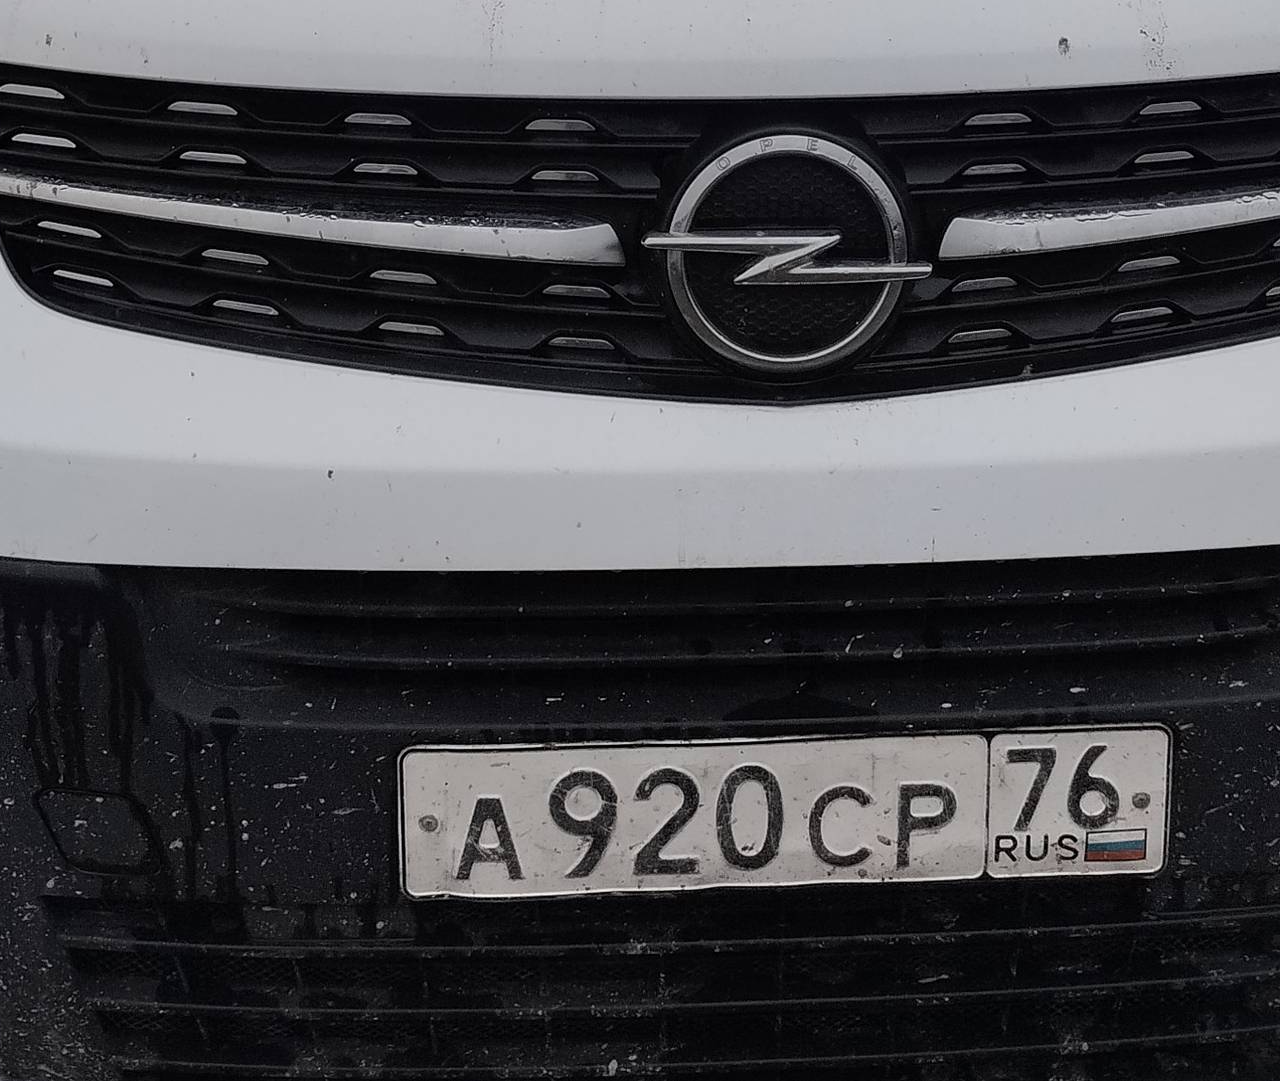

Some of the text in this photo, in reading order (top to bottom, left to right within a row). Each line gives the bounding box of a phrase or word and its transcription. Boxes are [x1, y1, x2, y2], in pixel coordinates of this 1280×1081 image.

[716, 138, 859, 171] OPEL
[1006, 744, 1120, 832] 76
[993, 833, 1080, 863] RUS
